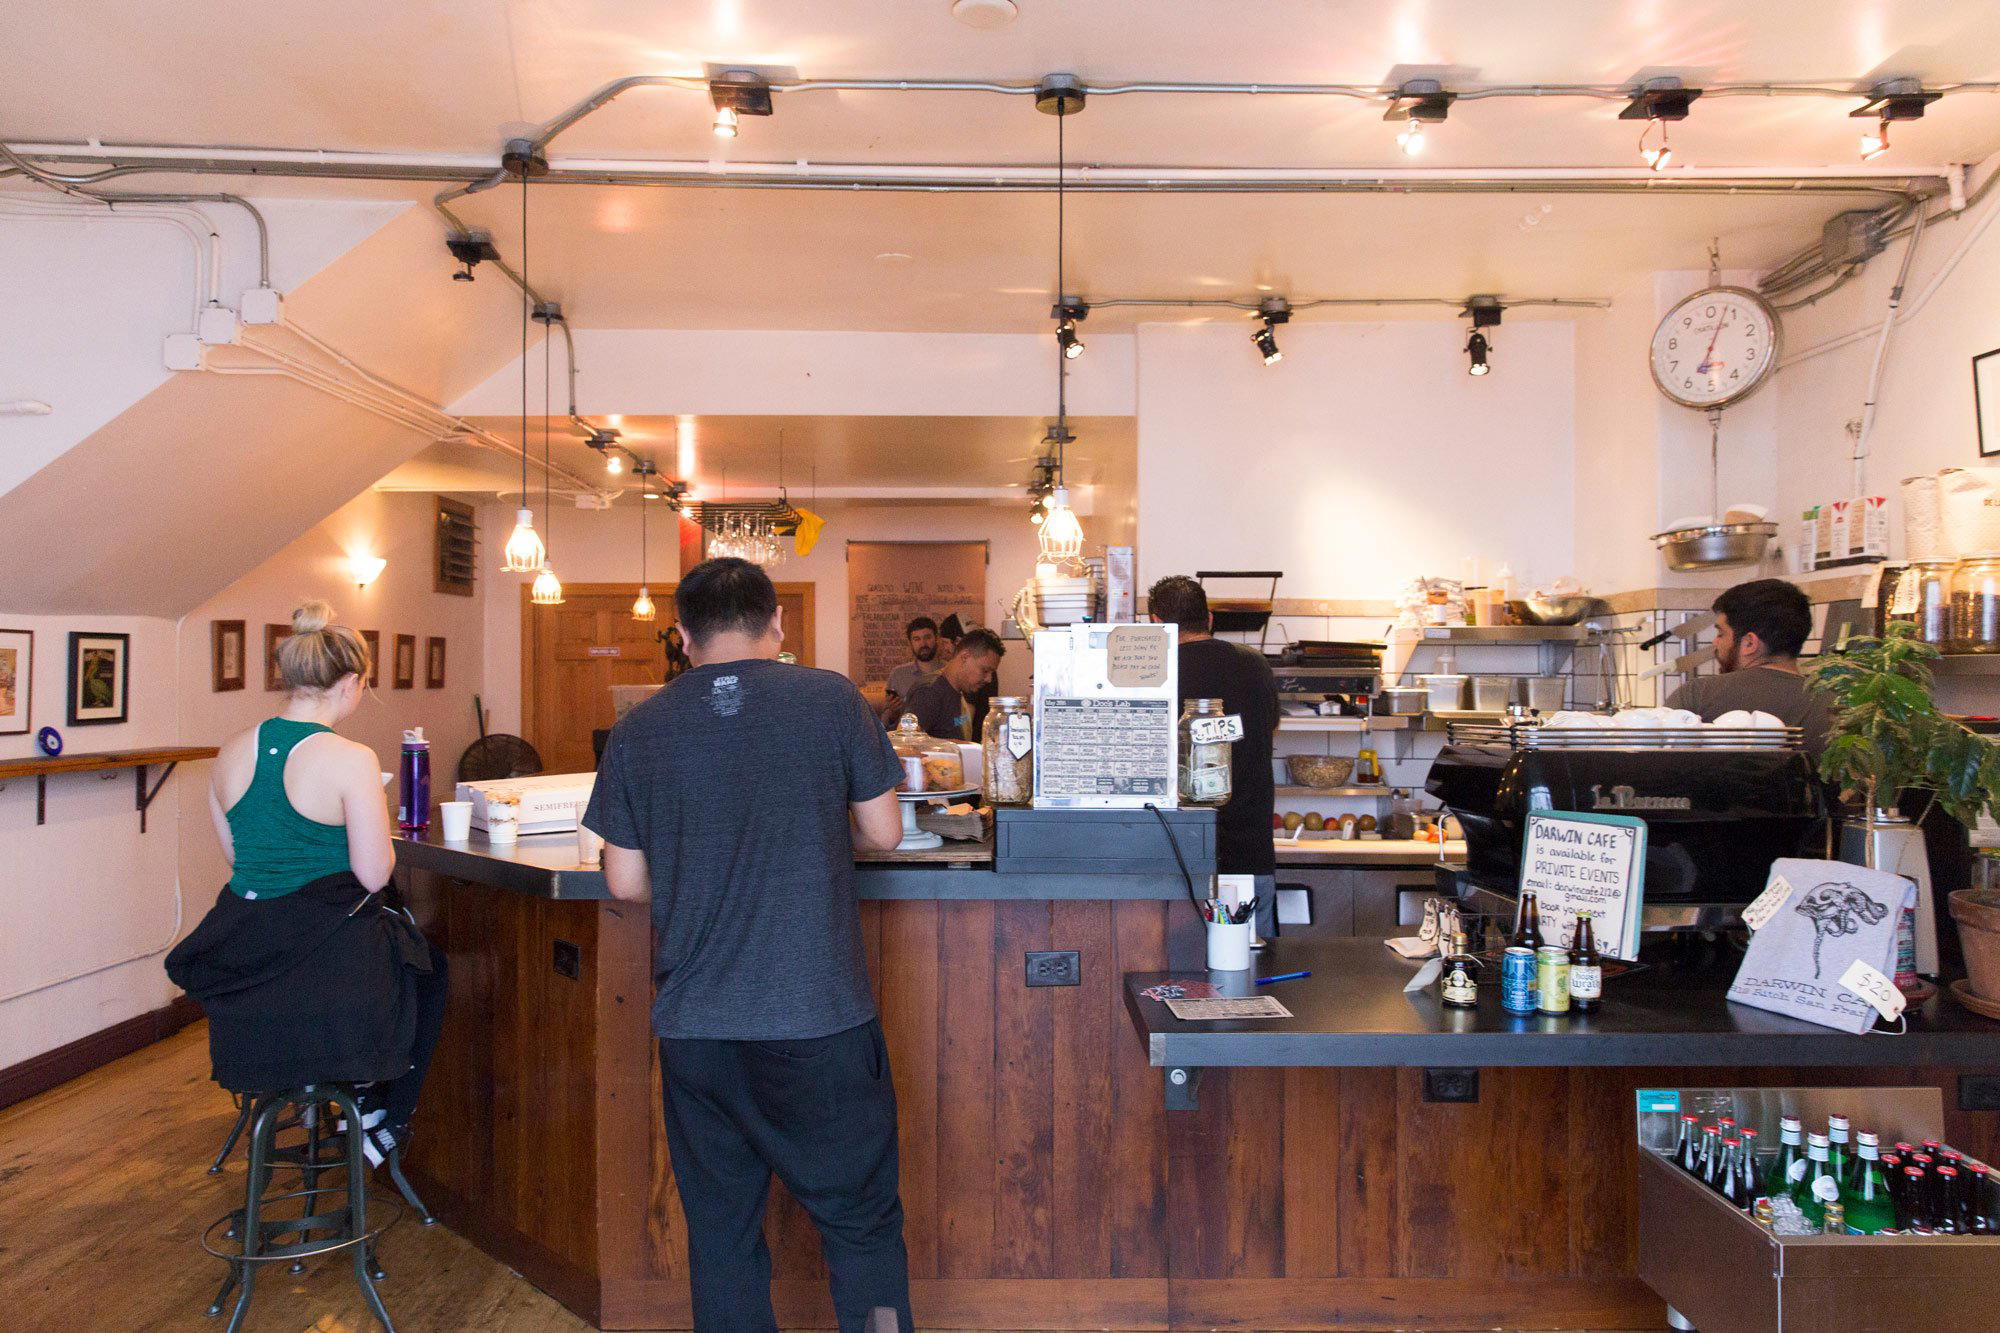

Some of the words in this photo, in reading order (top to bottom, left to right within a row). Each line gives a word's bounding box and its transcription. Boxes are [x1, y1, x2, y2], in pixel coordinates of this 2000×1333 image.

[1705, 306, 1716, 318] 0
[1731, 308, 1737, 320] 1
[1683, 317, 1692, 329] 9
[1746, 324, 1755, 337] 2
[1669, 338, 1678, 350] 8
[1746, 348, 1755, 360] 3
[1670, 361, 1678, 373] 7
[1730, 369, 1739, 381] 4
[1684, 377, 1692, 389] 6
[1707, 380, 1715, 392] 5
[1535, 824, 1583, 845] DARWIN
[1588, 832, 1617, 849] CAFE
[1536, 844, 1544, 854] is
[1550, 848, 1597, 861] available
[1600, 853, 1616, 864] for
[1535, 861, 1576, 878] PRIVATE
[1580, 867, 1619, 884] EVENTS
[1540, 901, 1560, 911] book
[1744, 977, 1827, 998] DARWIN
[1837, 993, 1873, 1009] CA
[1856, 973, 1891, 1001] $20
[1795, 995, 1827, 1010] San
